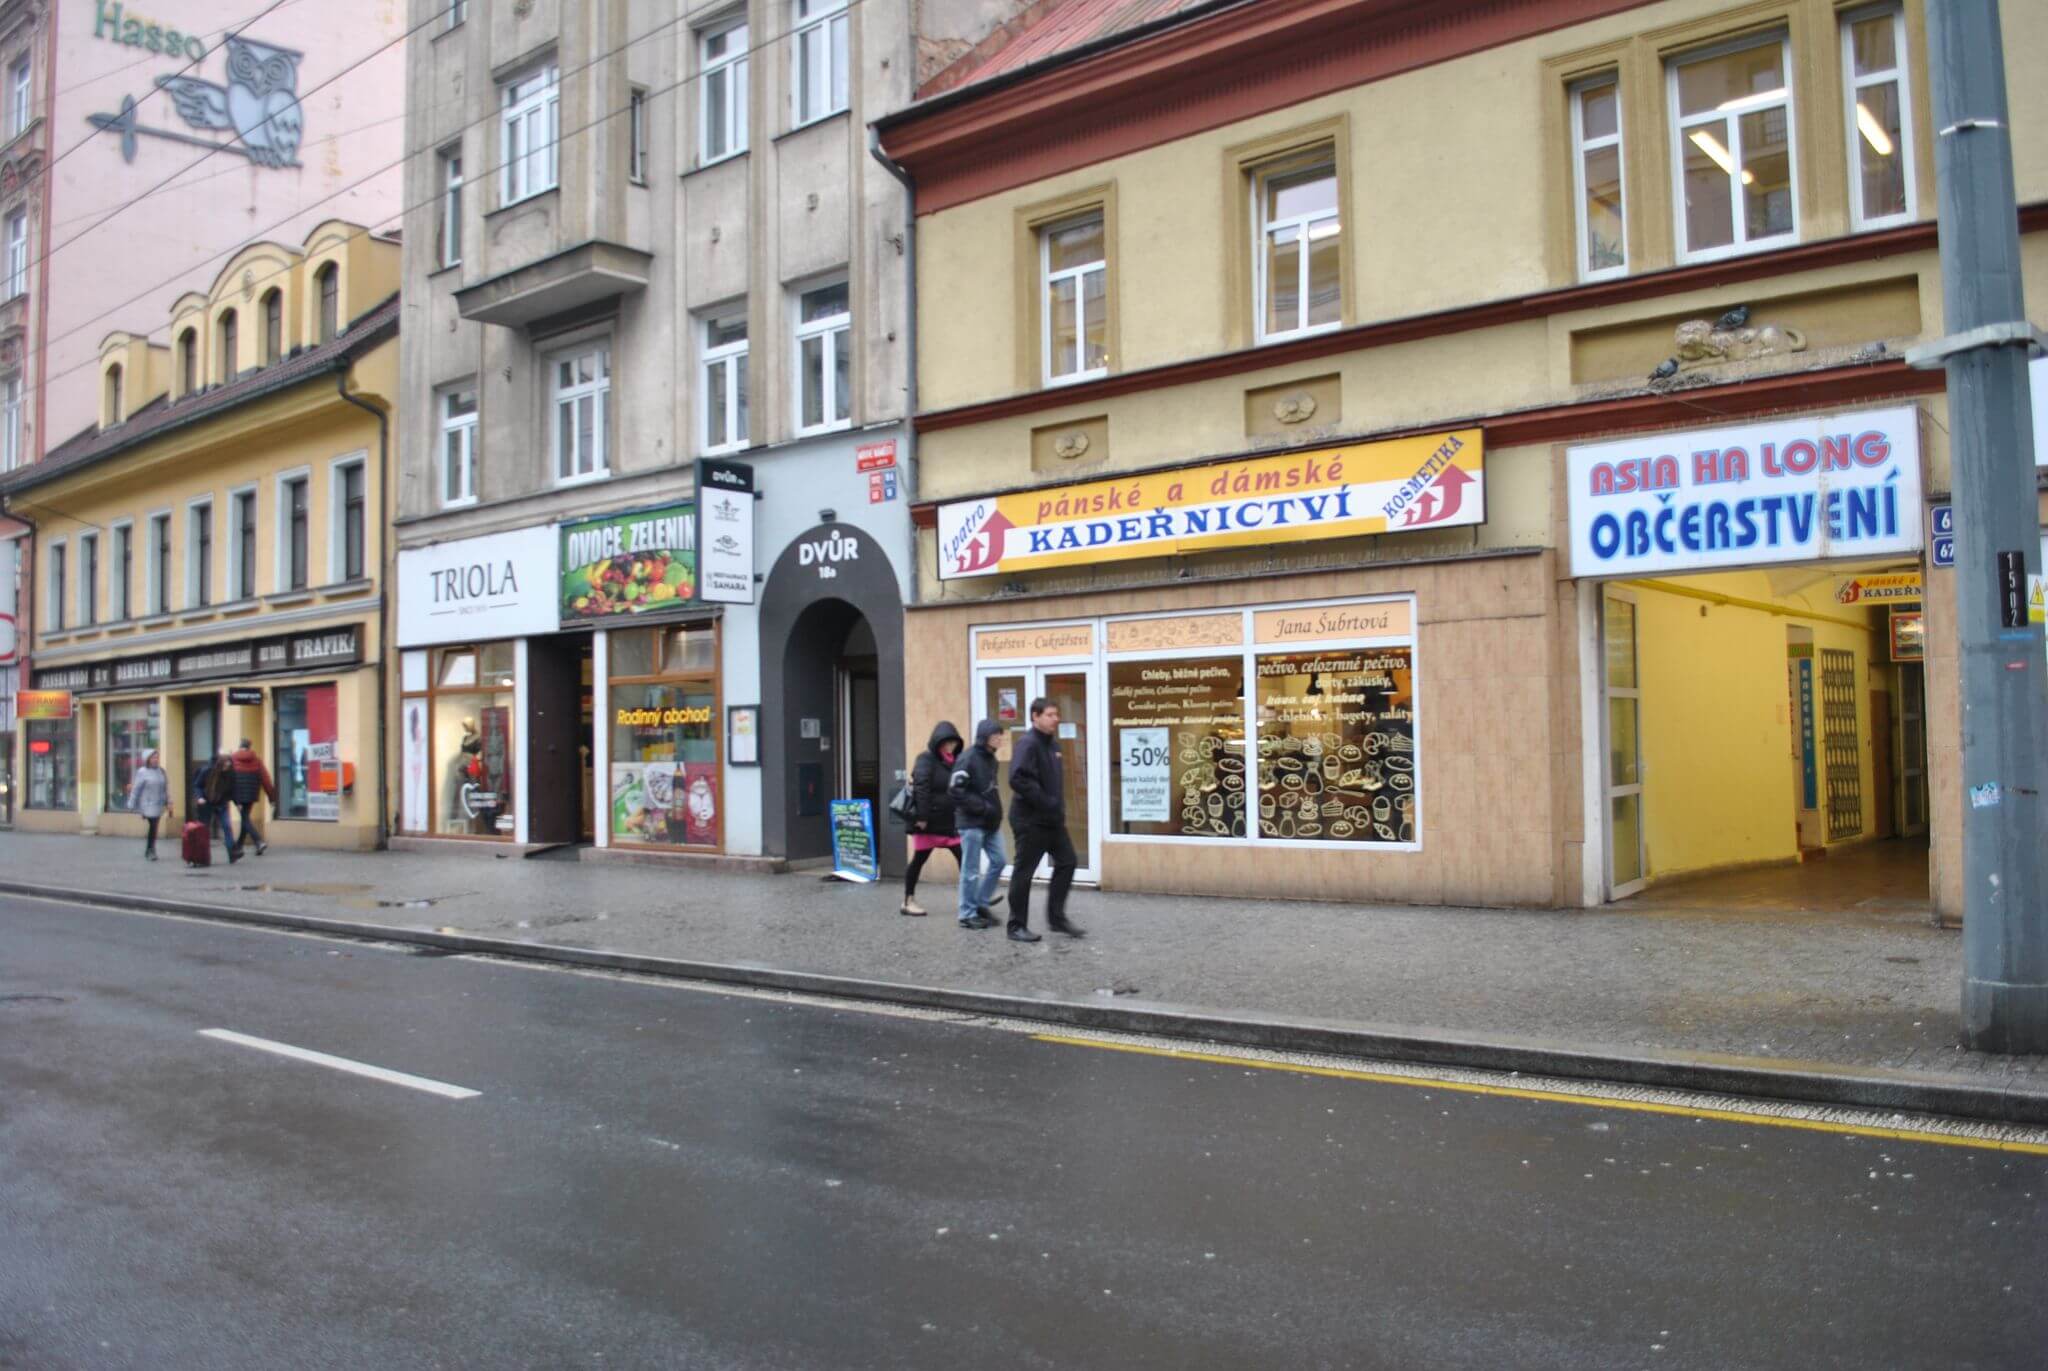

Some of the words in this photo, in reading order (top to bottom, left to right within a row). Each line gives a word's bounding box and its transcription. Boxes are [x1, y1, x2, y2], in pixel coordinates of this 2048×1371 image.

[94, 0, 206, 63] Hasso
[1036, 482, 1142, 524] pánské
[1167, 483, 1184, 501] a
[1211, 455, 1343, 496] dámské
[1382, 435, 1465, 520] KOSMETIKA
[1590, 455, 1680, 496] ASIA
[1692, 446, 1750, 485] HA
[1761, 430, 1891, 477] LONG
[1029, 484, 1352, 552] KADEŘNICTVÍ
[1590, 465, 1901, 561] OBČERSTVENÍ
[568, 525, 623, 572] OVOCE
[799, 530, 858, 565] DVŮR
[430, 560, 519, 602] TRIOLA
[1274, 618, 1312, 639] Jana
[1315, 611, 1389, 634] Šubrtová
[617, 706, 662, 728] Rodinný
[664, 706, 711, 725] obchod
[1124, 747, 1170, 767] -50%
